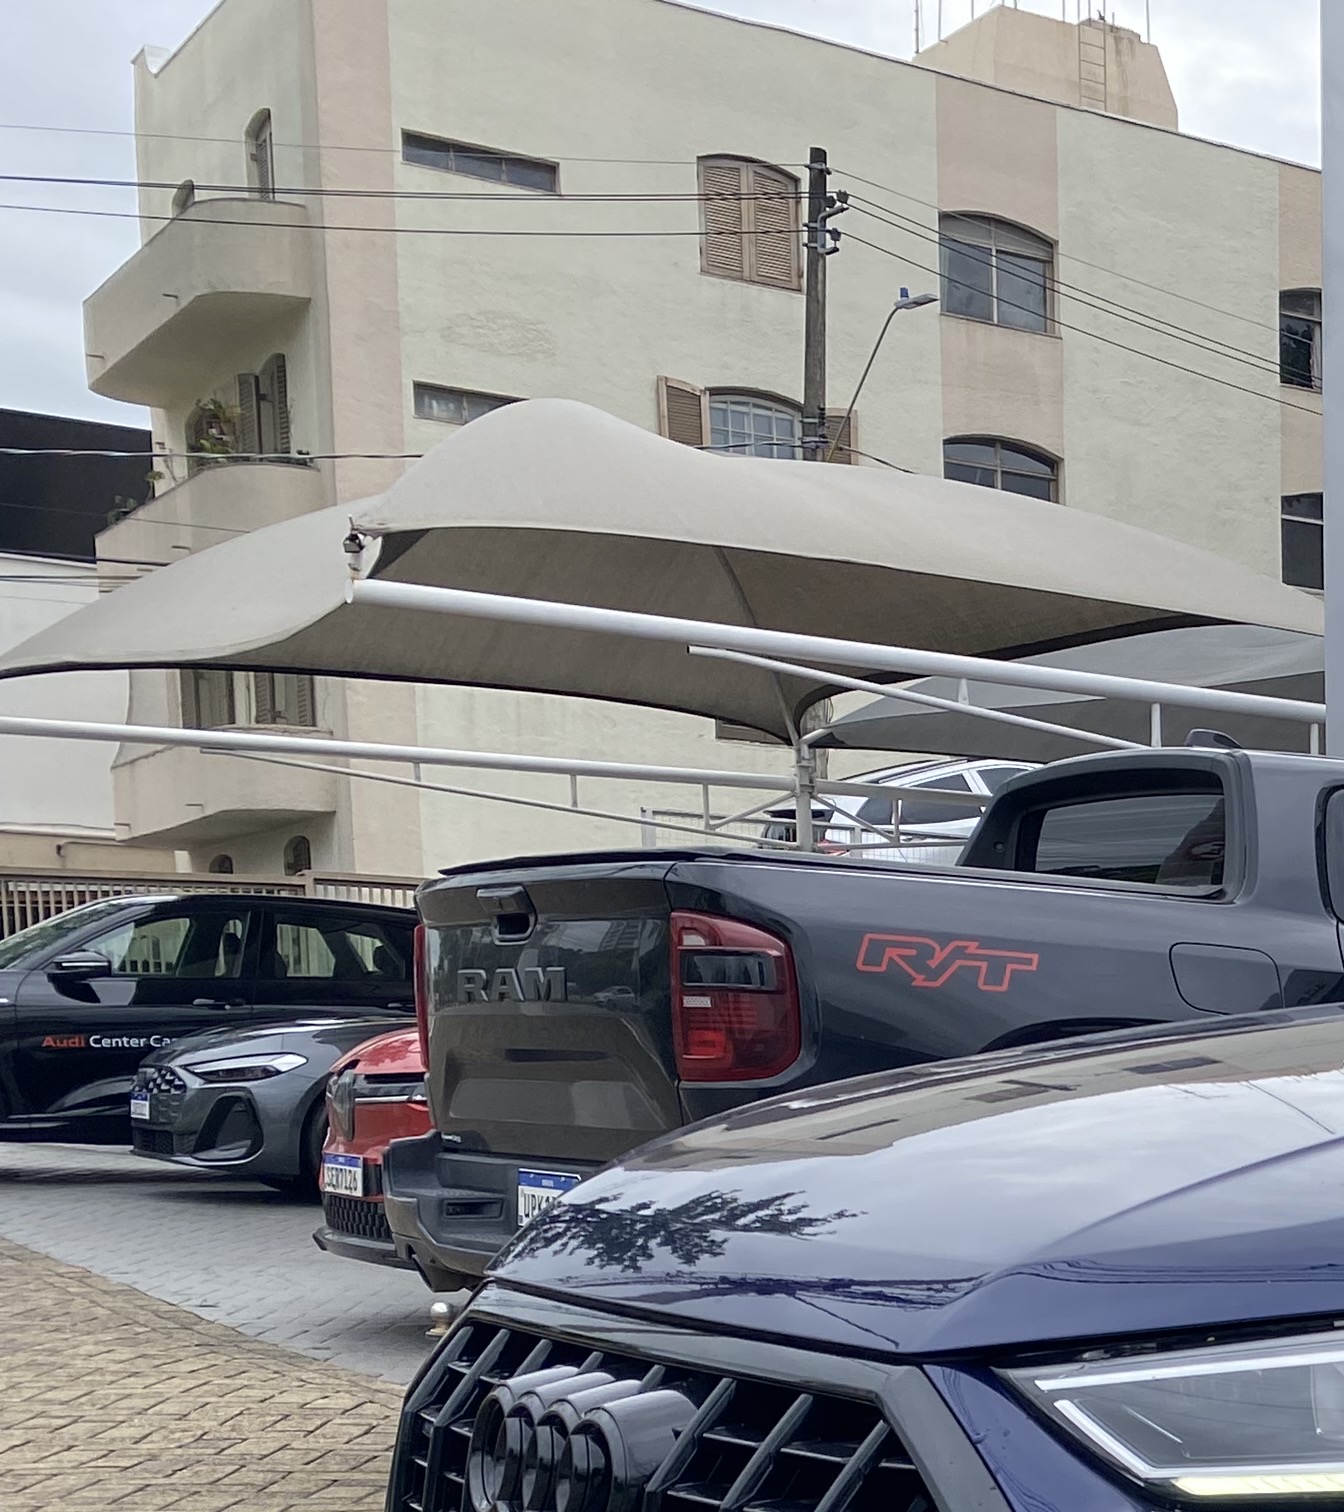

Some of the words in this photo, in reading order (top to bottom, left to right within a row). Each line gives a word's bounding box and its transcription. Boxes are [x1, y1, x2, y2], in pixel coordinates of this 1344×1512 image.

[457, 967, 568, 1001] RAM
[41, 1035, 85, 1048] Audi
[89, 1035, 146, 1048] Center
